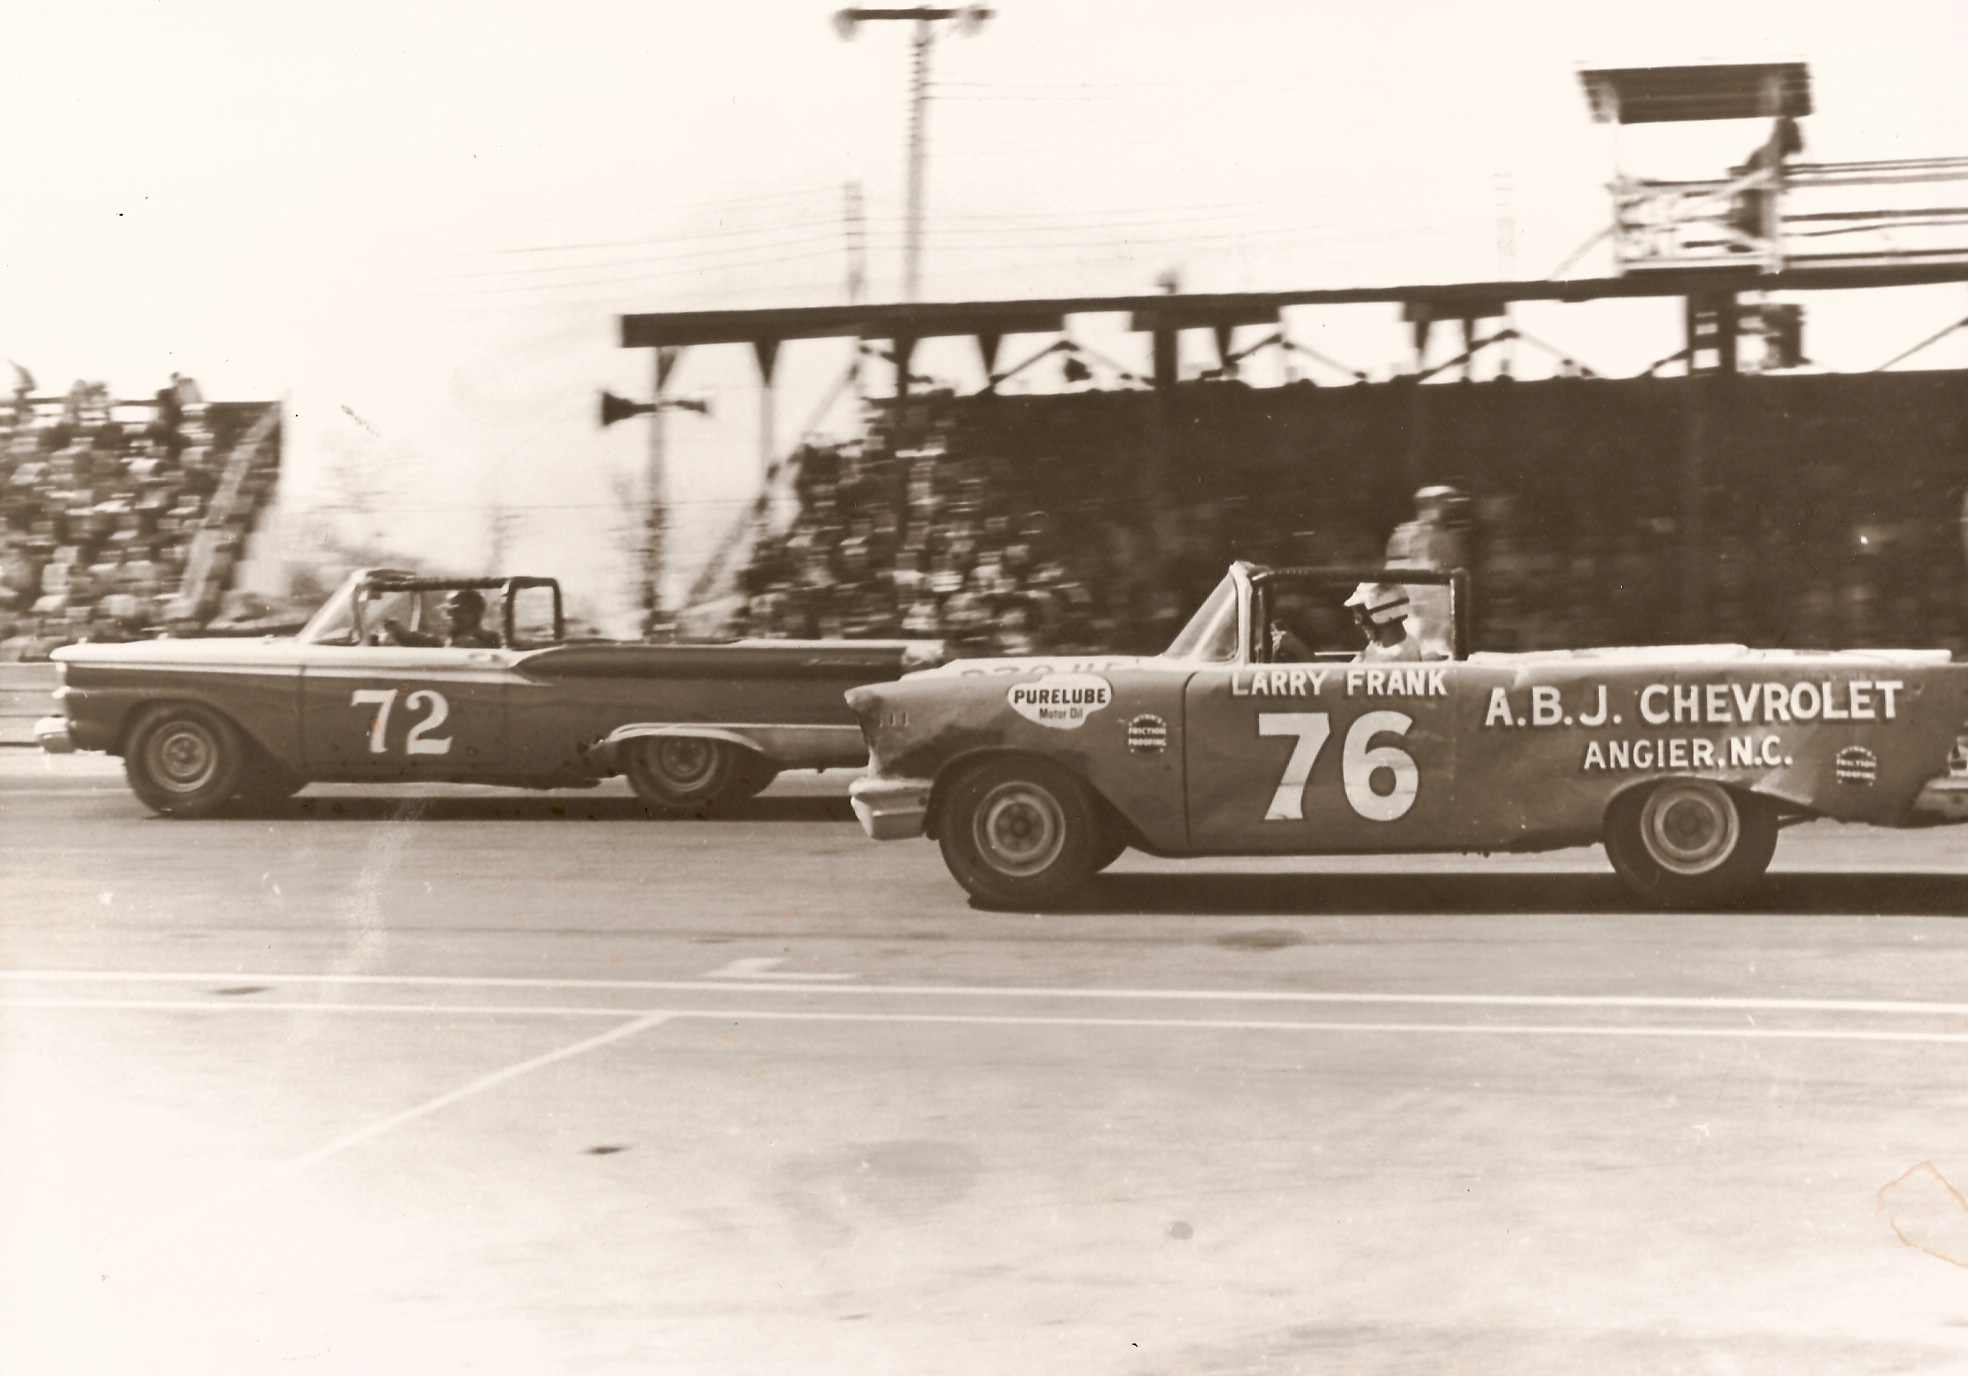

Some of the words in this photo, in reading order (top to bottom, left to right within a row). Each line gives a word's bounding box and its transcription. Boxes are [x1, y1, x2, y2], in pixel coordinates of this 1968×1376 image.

[1014, 688, 1106, 704] PURELUBE
[1231, 670, 1328, 696] LARRY
[1346, 669, 1448, 697] FRANK
[350, 689, 453, 754] 72
[1039, 707, 1067, 719] Motor
[1070, 707, 1083, 719] Oil
[1485, 684, 1622, 726] A.B.J.
[1640, 680, 1904, 724] CHEVROLET
[1258, 710, 1419, 822] 76
